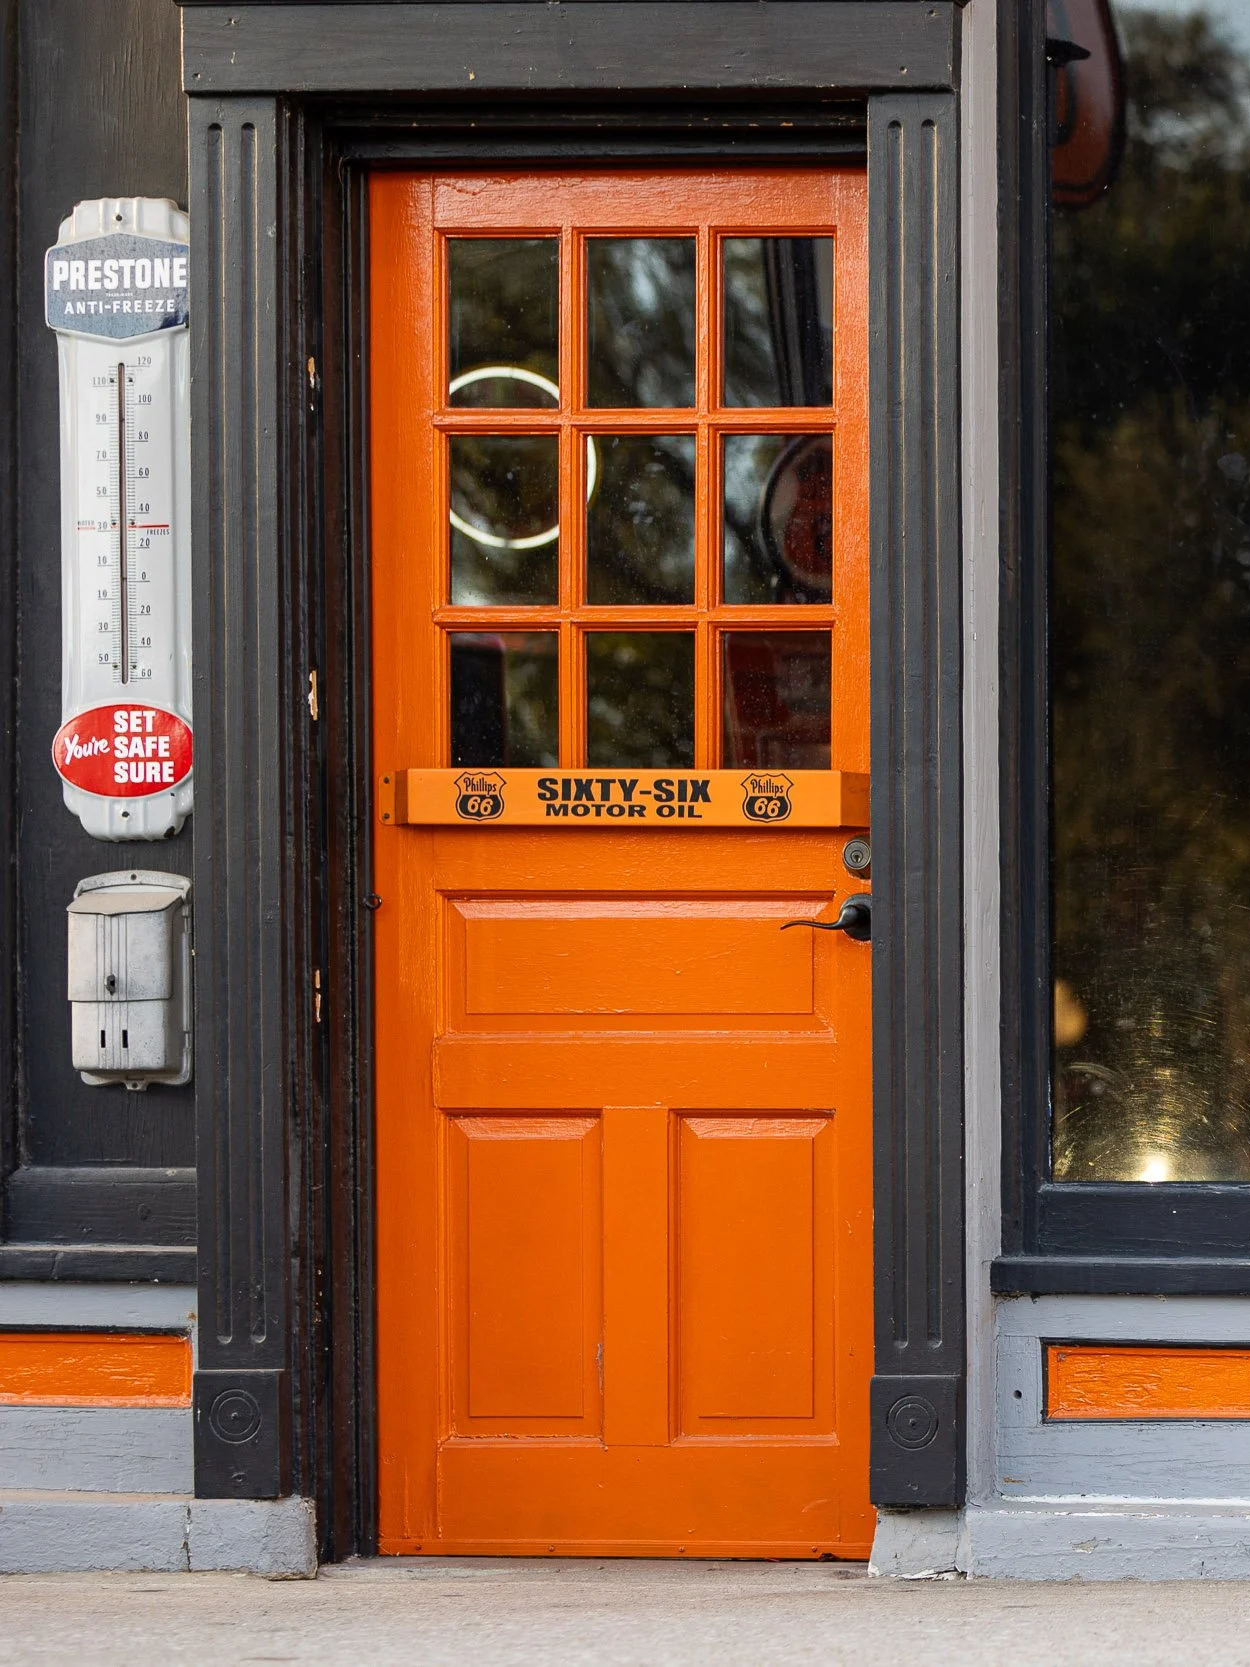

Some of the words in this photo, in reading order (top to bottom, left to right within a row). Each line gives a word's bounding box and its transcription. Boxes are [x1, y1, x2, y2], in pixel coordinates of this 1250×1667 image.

[53, 257, 187, 290] PRESTONE
[64, 299, 175, 314] ANTI-FREEZE
[137, 356, 152, 365] 120
[92, 376, 106, 385] 110
[138, 394, 152, 403] 100
[96, 413, 107, 422] 90
[138, 431, 149, 440] 80
[96, 450, 107, 459] 70
[138, 467, 149, 476] 60
[96, 486, 107, 495] 50
[139, 503, 150, 512] 40
[140, 537, 150, 547] 20
[97, 556, 107, 565] 10
[141, 571, 147, 580] 0
[97, 589, 107, 598] 10
[140, 605, 151, 614] 20
[98, 622, 108, 631] 30
[140, 637, 151, 646] 40
[98, 653, 109, 662] 50
[141, 669, 152, 678] 60
[113, 710, 156, 733] SET
[63, 733, 111, 765] You're
[113, 736, 170, 758] SAFE
[113, 761, 175, 783] SURE
[463, 777, 497, 797] Phillips
[537, 777, 712, 803] SIXTY-SIX
[750, 778, 784, 798] Phillips
[467, 796, 493, 815] 66
[754, 797, 781, 817] 66
[545, 803, 647, 817] MOTOR
[656, 804, 703, 818] OIL
